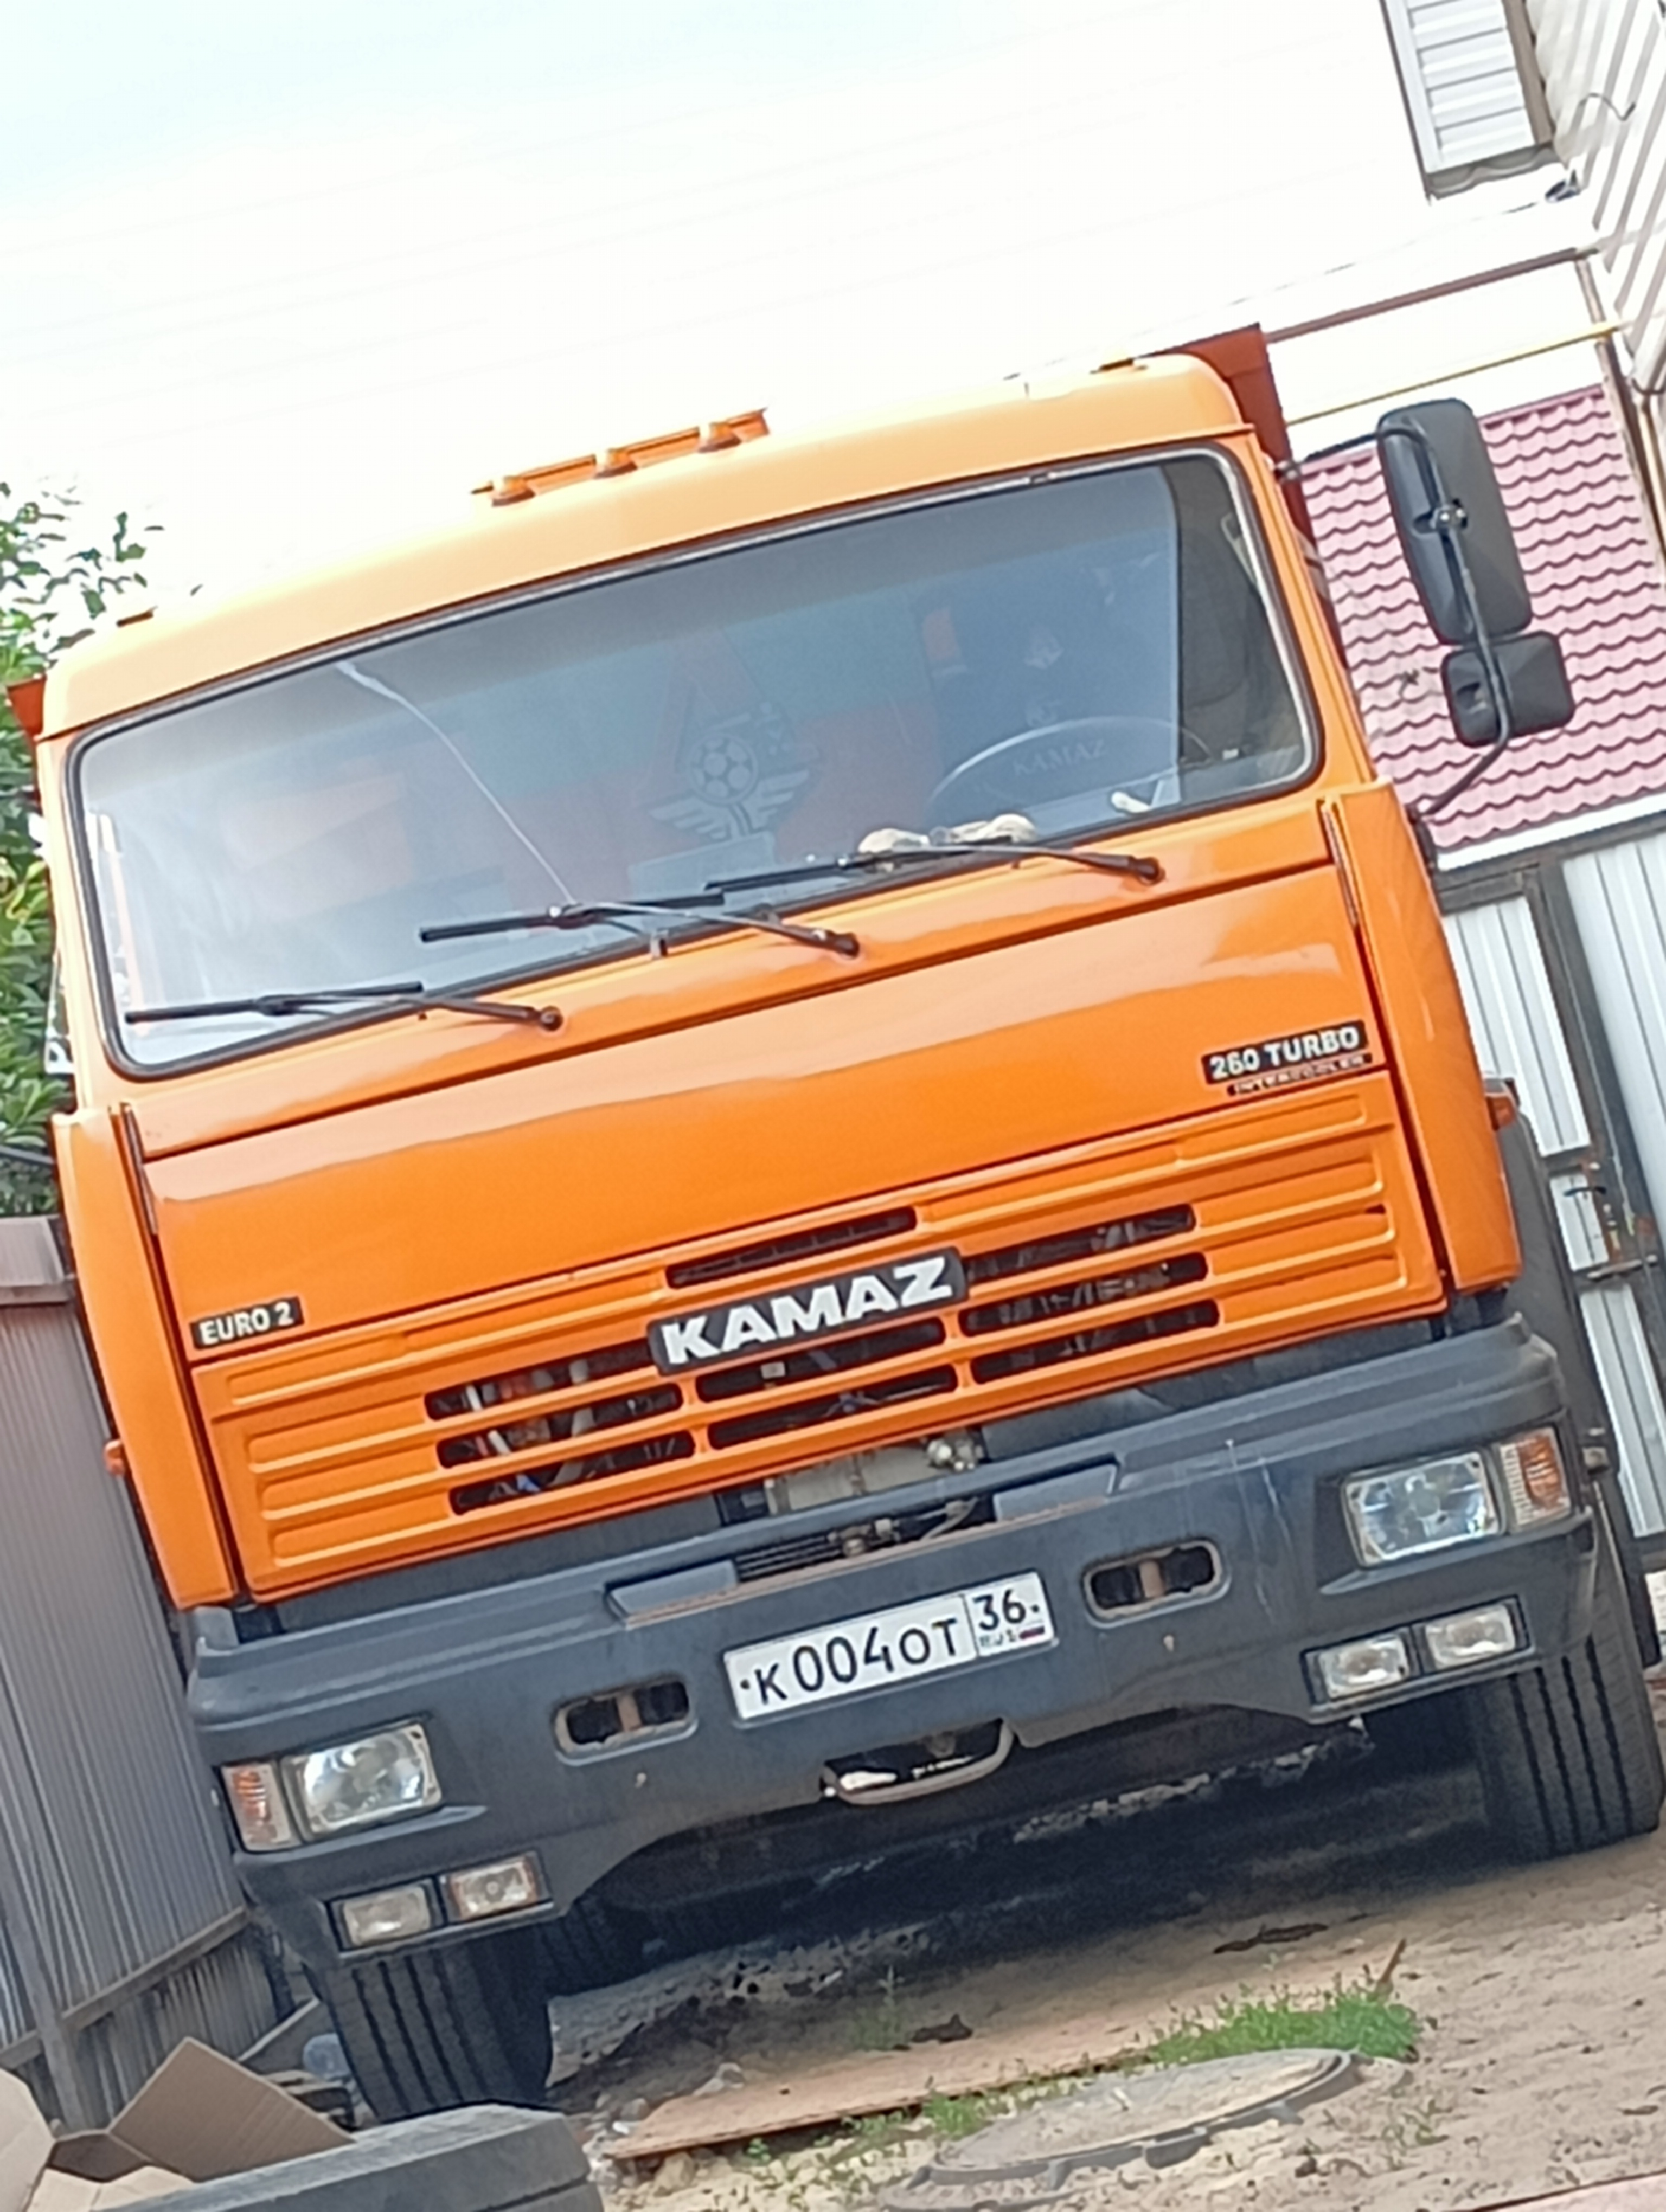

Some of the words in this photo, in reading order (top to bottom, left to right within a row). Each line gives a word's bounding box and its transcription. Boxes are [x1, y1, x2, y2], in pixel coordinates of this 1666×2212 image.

[1209, 1047, 1260, 1080] 260
[1264, 1026, 1360, 1066] TURBO
[198, 1307, 270, 1345] EURO
[274, 1301, 294, 1327] 2
[661, 1256, 953, 1364] KAMAZ
[972, 1589, 1026, 1631] 36
